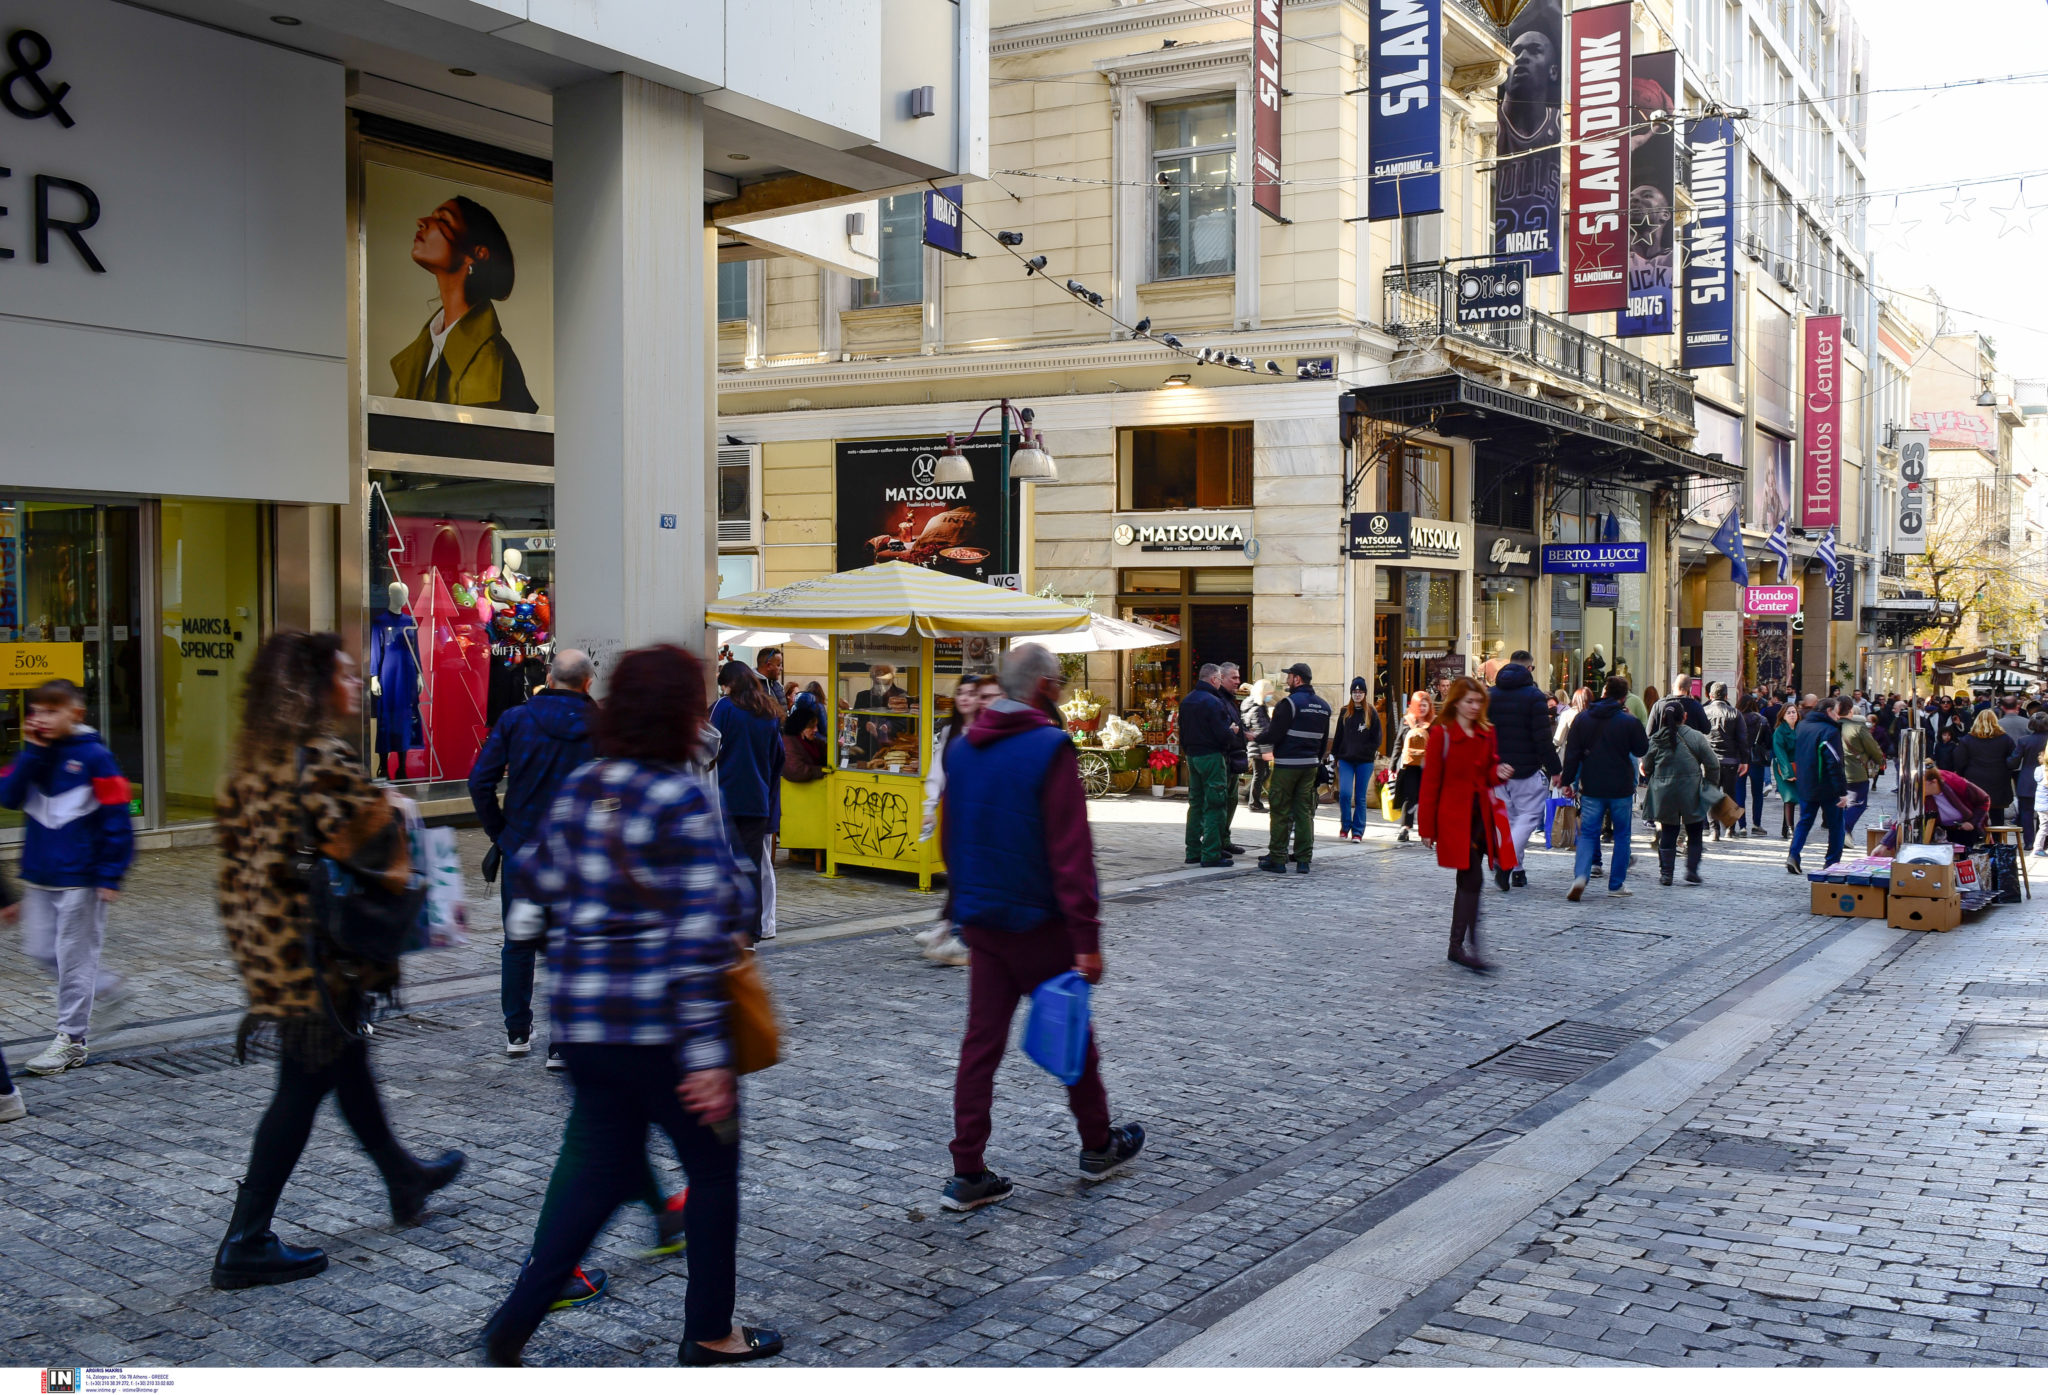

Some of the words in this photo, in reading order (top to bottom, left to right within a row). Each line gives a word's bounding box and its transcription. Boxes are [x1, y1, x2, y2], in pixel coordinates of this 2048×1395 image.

[932, 193, 957, 228] NBA75
[1505, 229, 1549, 253] NBA75
[1459, 304, 1522, 320] TATTOO
[1625, 295, 1663, 318] NBA75
[1808, 330, 1833, 413] Center
[1808, 422, 1832, 515] Hondos
[885, 486, 967, 502] MATSOUKA
[663, 516, 674, 528] 33
[1139, 524, 1244, 542] MATSOUKA
[1355, 536, 1403, 545] MATSOUKA
[1548, 549, 1591, 560] BERTO
[1599, 548, 1640, 559] LUCCI
[993, 576, 1016, 587] WC
[1592, 583, 1606, 593] BERTO
[1834, 560, 1846, 616] MANGO
[1749, 589, 1794, 601] Hondos
[1748, 600, 1789, 611] Center
[182, 618, 222, 635] MARKS
[223, 618, 231, 634] &
[180, 642, 234, 659] SPENCER
[491, 645, 522, 656] GIFTS
[14, 654, 49, 669] 50%
